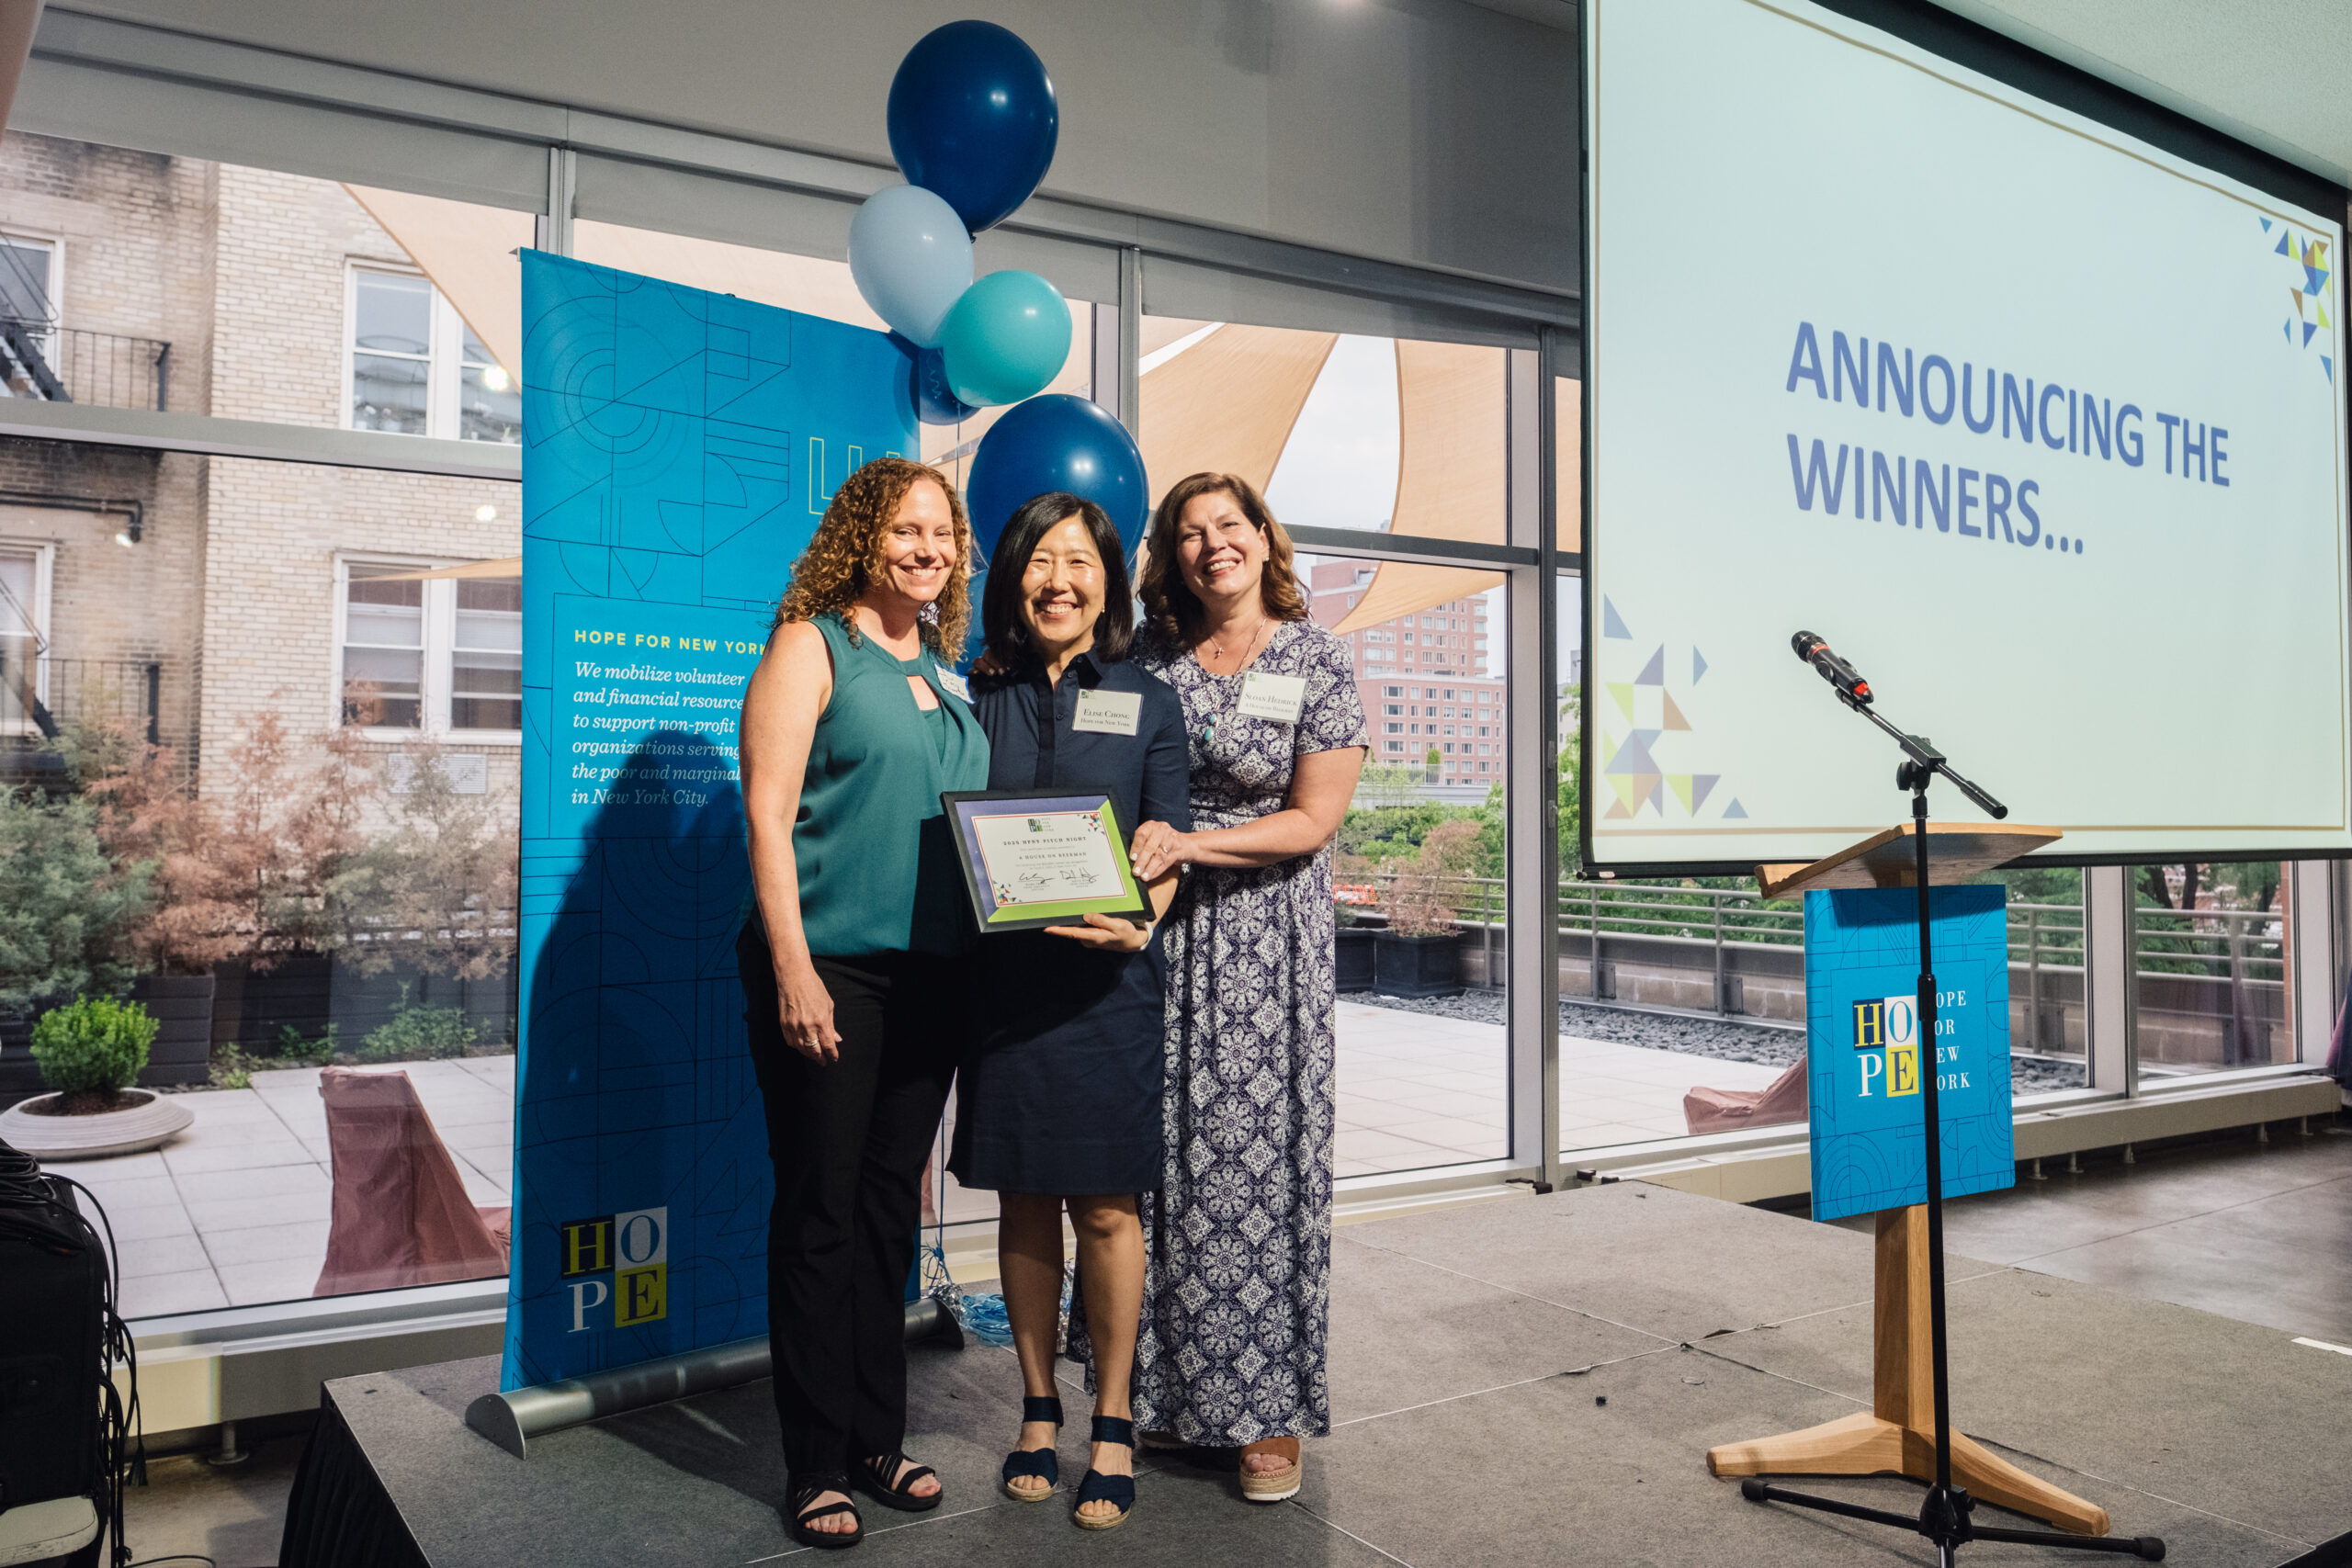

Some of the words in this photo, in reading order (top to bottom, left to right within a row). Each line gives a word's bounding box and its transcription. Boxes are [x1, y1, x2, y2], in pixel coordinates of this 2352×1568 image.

[1786, 321, 2144, 468] ANNOUNCING
[2156, 412, 2230, 488] THE
[1786, 433, 2083, 555] WINNERS...
[574, 630, 626, 645] HOPE
[635, 634, 671, 649] FOR
[679, 637, 717, 651] NEW
[575, 661, 602, 678] We
[605, 664, 672, 682] mobilize
[674, 668, 745, 685] volunteer
[573, 688, 605, 704] and
[606, 688, 680, 706] financial
[573, 714, 589, 728] to
[593, 716, 656, 731] support
[659, 717, 735, 735] non-profit
[571, 739, 684, 756] organizations
[687, 742, 740, 760] serving
[571, 762, 598, 779] the
[599, 767, 638, 782] poor
[639, 764, 671, 780] and
[571, 789, 589, 804] in
[591, 789, 628, 805] New
[634, 789, 670, 805] York
[673, 789, 709, 807] City.
[1936, 990, 1966, 1008] OPE
[1934, 1019, 1955, 1035] OR
[1936, 1045, 1960, 1063] EW
[1937, 1072, 1970, 1091] ORK
